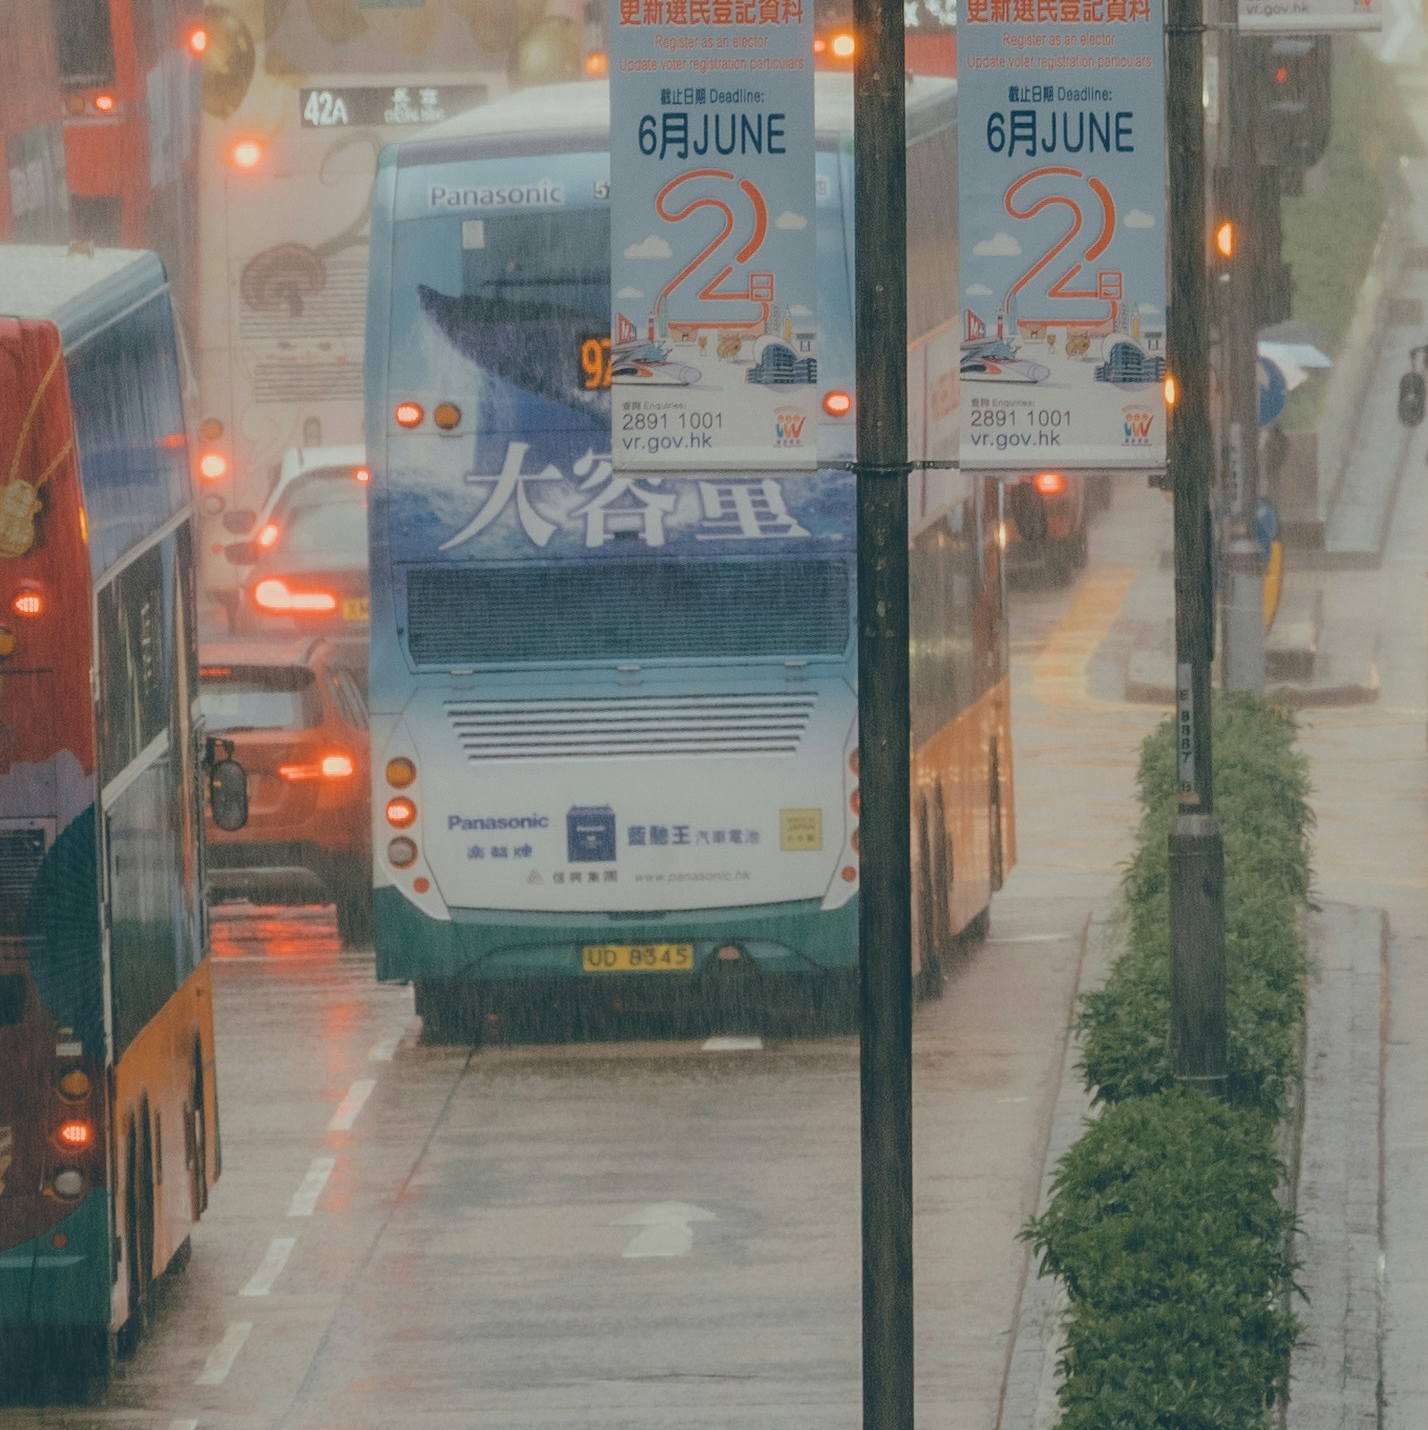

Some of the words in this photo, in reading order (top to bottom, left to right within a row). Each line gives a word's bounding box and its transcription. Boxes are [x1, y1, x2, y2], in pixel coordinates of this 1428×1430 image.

[655, 34, 698, 52] Register
[701, 36, 714, 48] as
[716, 36, 730, 48] an
[732, 34, 769, 48] elector
[1003, 33, 1046, 50] Register
[1049, 35, 1061, 46] as
[1064, 35, 1077, 46] an
[1079, 33, 1116, 46] elector
[619, 58, 657, 73] Update
[661, 59, 686, 70] voter
[689, 58, 746, 74] registration
[750, 56, 805, 73] particulars
[966, 55, 1006, 70] Update
[1008, 56, 1034, 68] voter
[1037, 54, 1094, 72] registration
[1097, 54, 1153, 71] particulars
[660, 88, 706, 105] 截止日期
[709, 88, 765, 104] Deadline:
[1008, 85, 1055, 103] 截止日期
[1057, 85, 1113, 102] Deadline:
[303, 90, 349, 127] 42A
[429, 182, 563, 208] Panasonic
[622, 412, 668, 431] 2891
[678, 412, 723, 430] 1001
[970, 409, 1017, 428] 2891
[1027, 409, 1072, 427] 1001
[622, 433, 713, 453] vr.gov.hk
[970, 430, 1061, 450] vr.gov.hk
[448, 812, 550, 831] Panasonic
